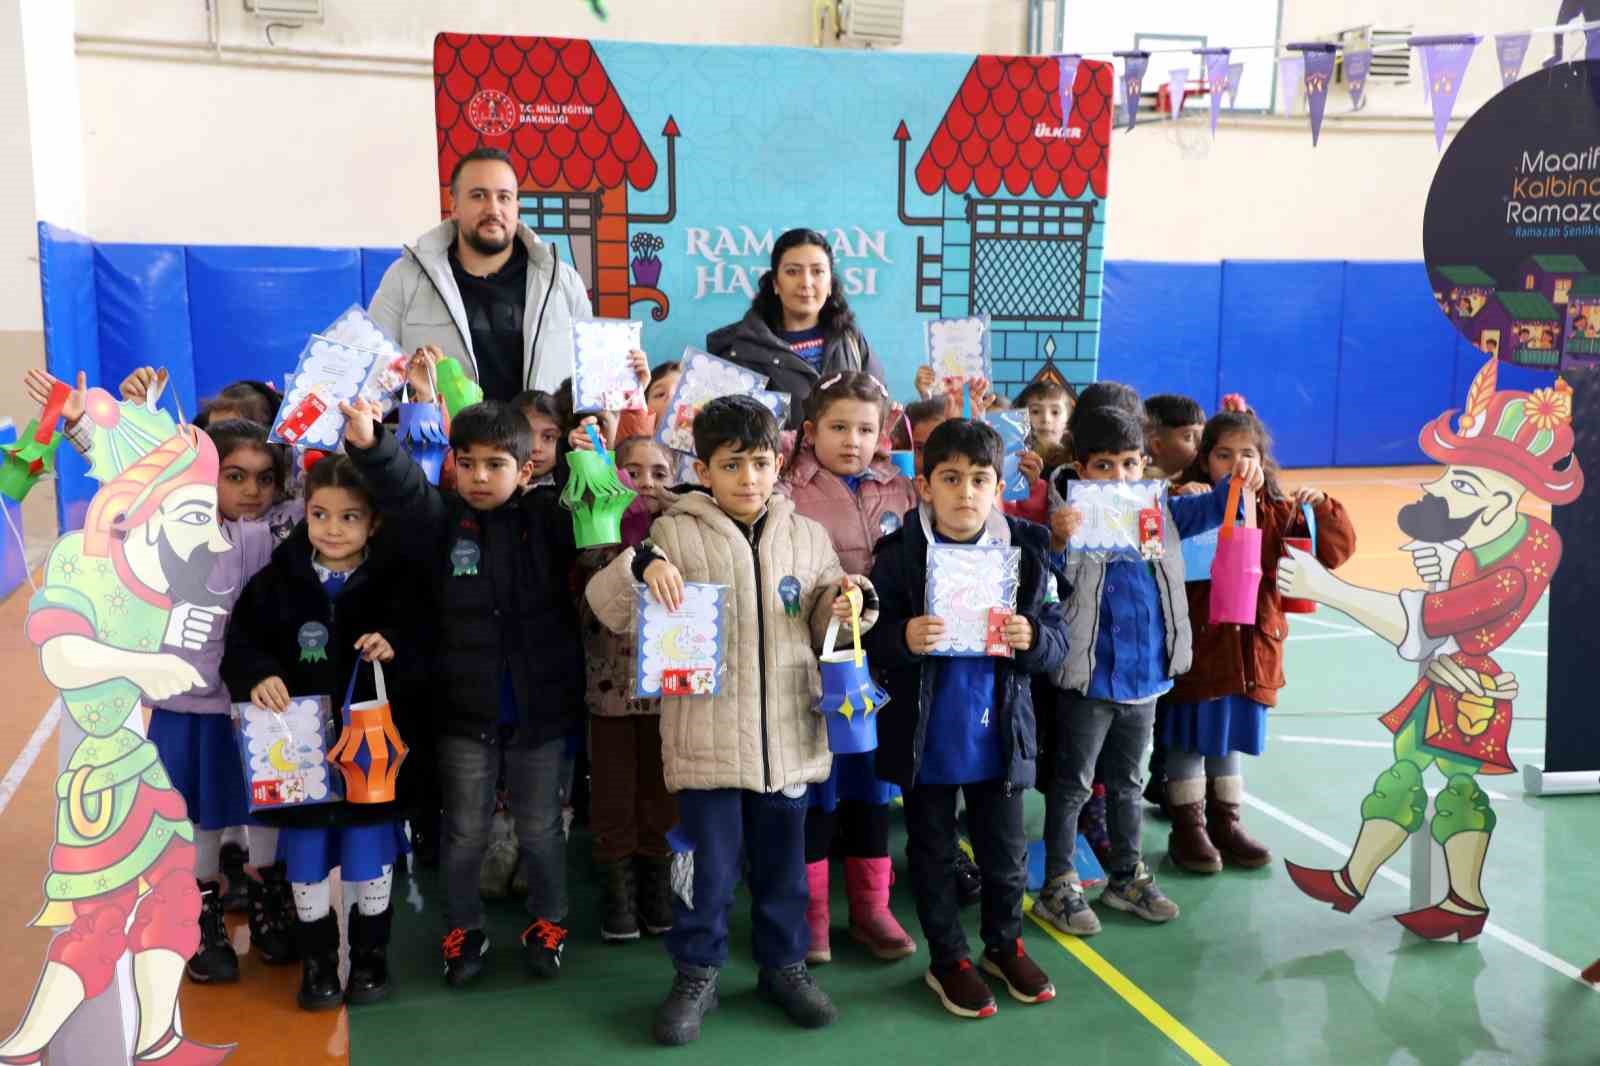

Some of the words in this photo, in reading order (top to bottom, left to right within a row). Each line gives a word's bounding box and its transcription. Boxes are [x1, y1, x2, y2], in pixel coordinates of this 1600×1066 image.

[519, 104, 535, 113] T.C.
[519, 114, 569, 124] BAKANLIĞI
[1514, 225, 1561, 238] Ramazan
[686, 225, 892, 264] RAMAN
[980, 707, 990, 727] 4
